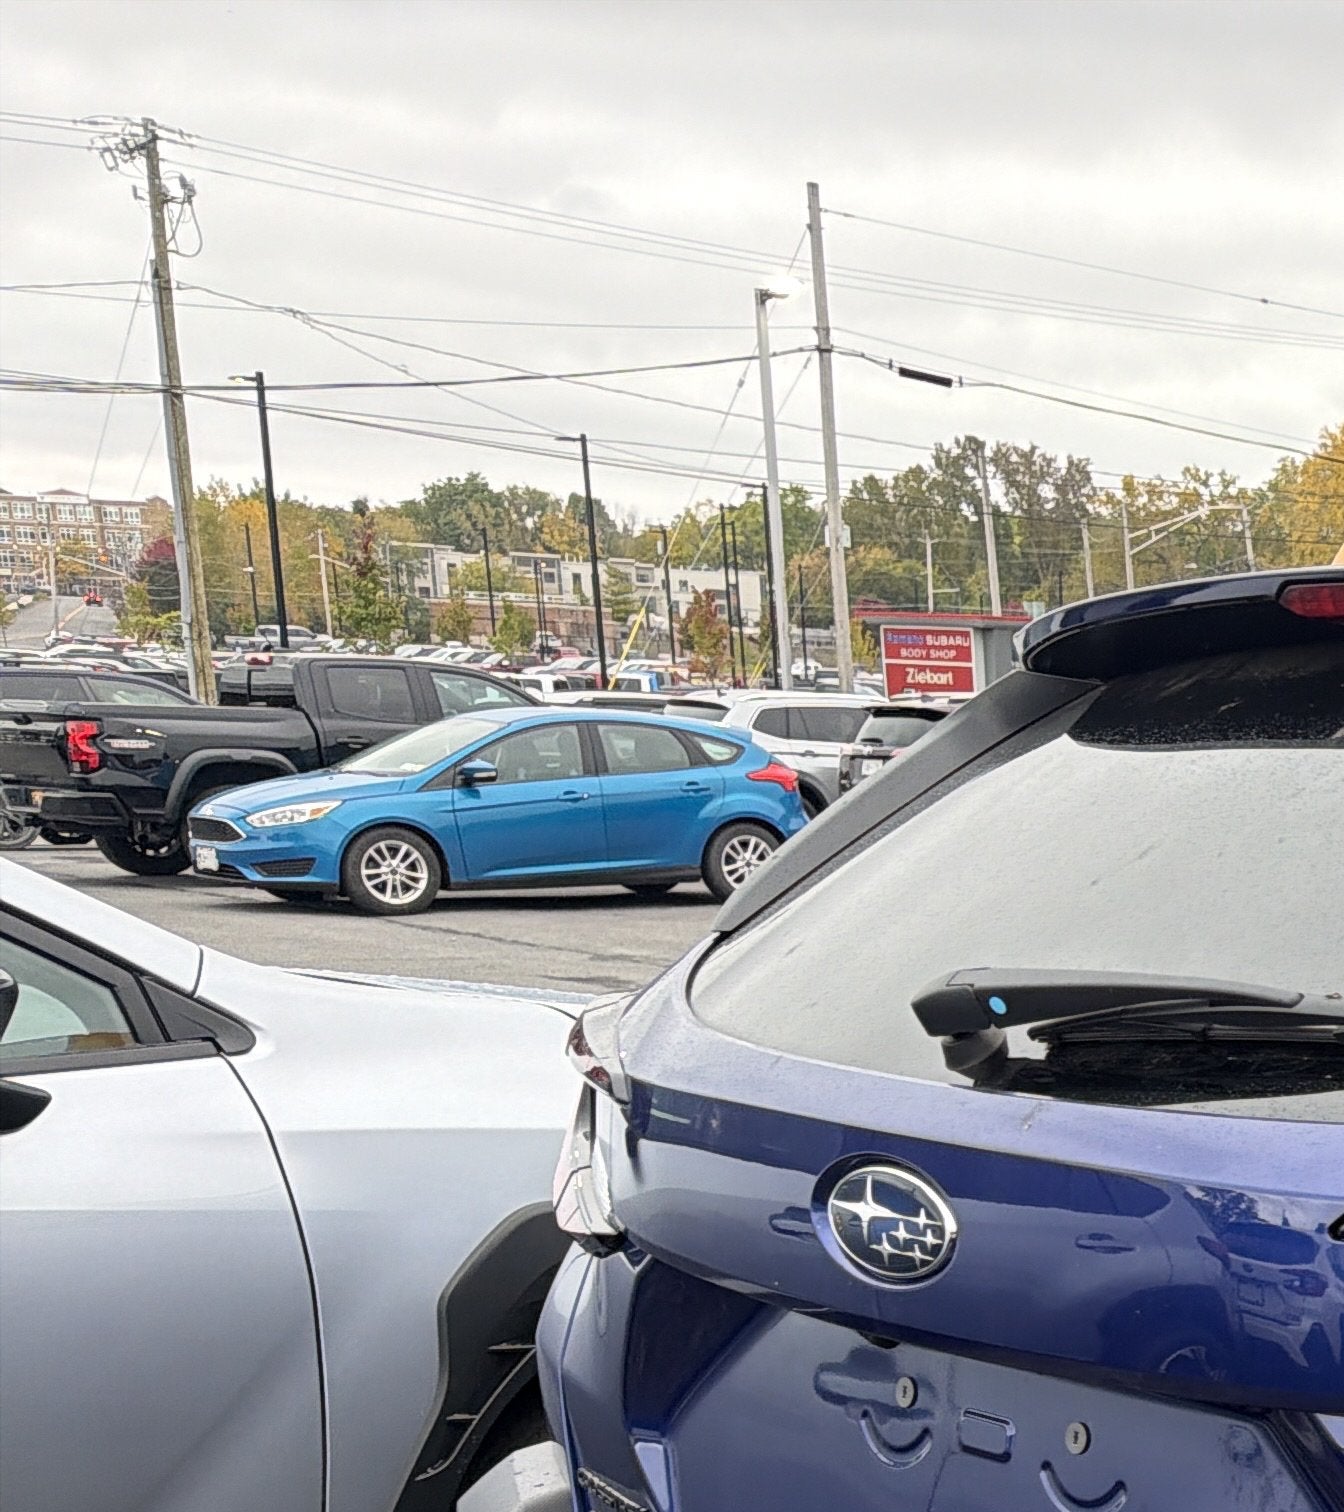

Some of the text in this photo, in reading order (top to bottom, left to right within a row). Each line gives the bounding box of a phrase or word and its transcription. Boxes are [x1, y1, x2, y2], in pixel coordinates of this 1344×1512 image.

[925, 634, 970, 647] SUBARU
[900, 647, 957, 660] BODY SHOP
[904, 667, 954, 686] Ziebart
